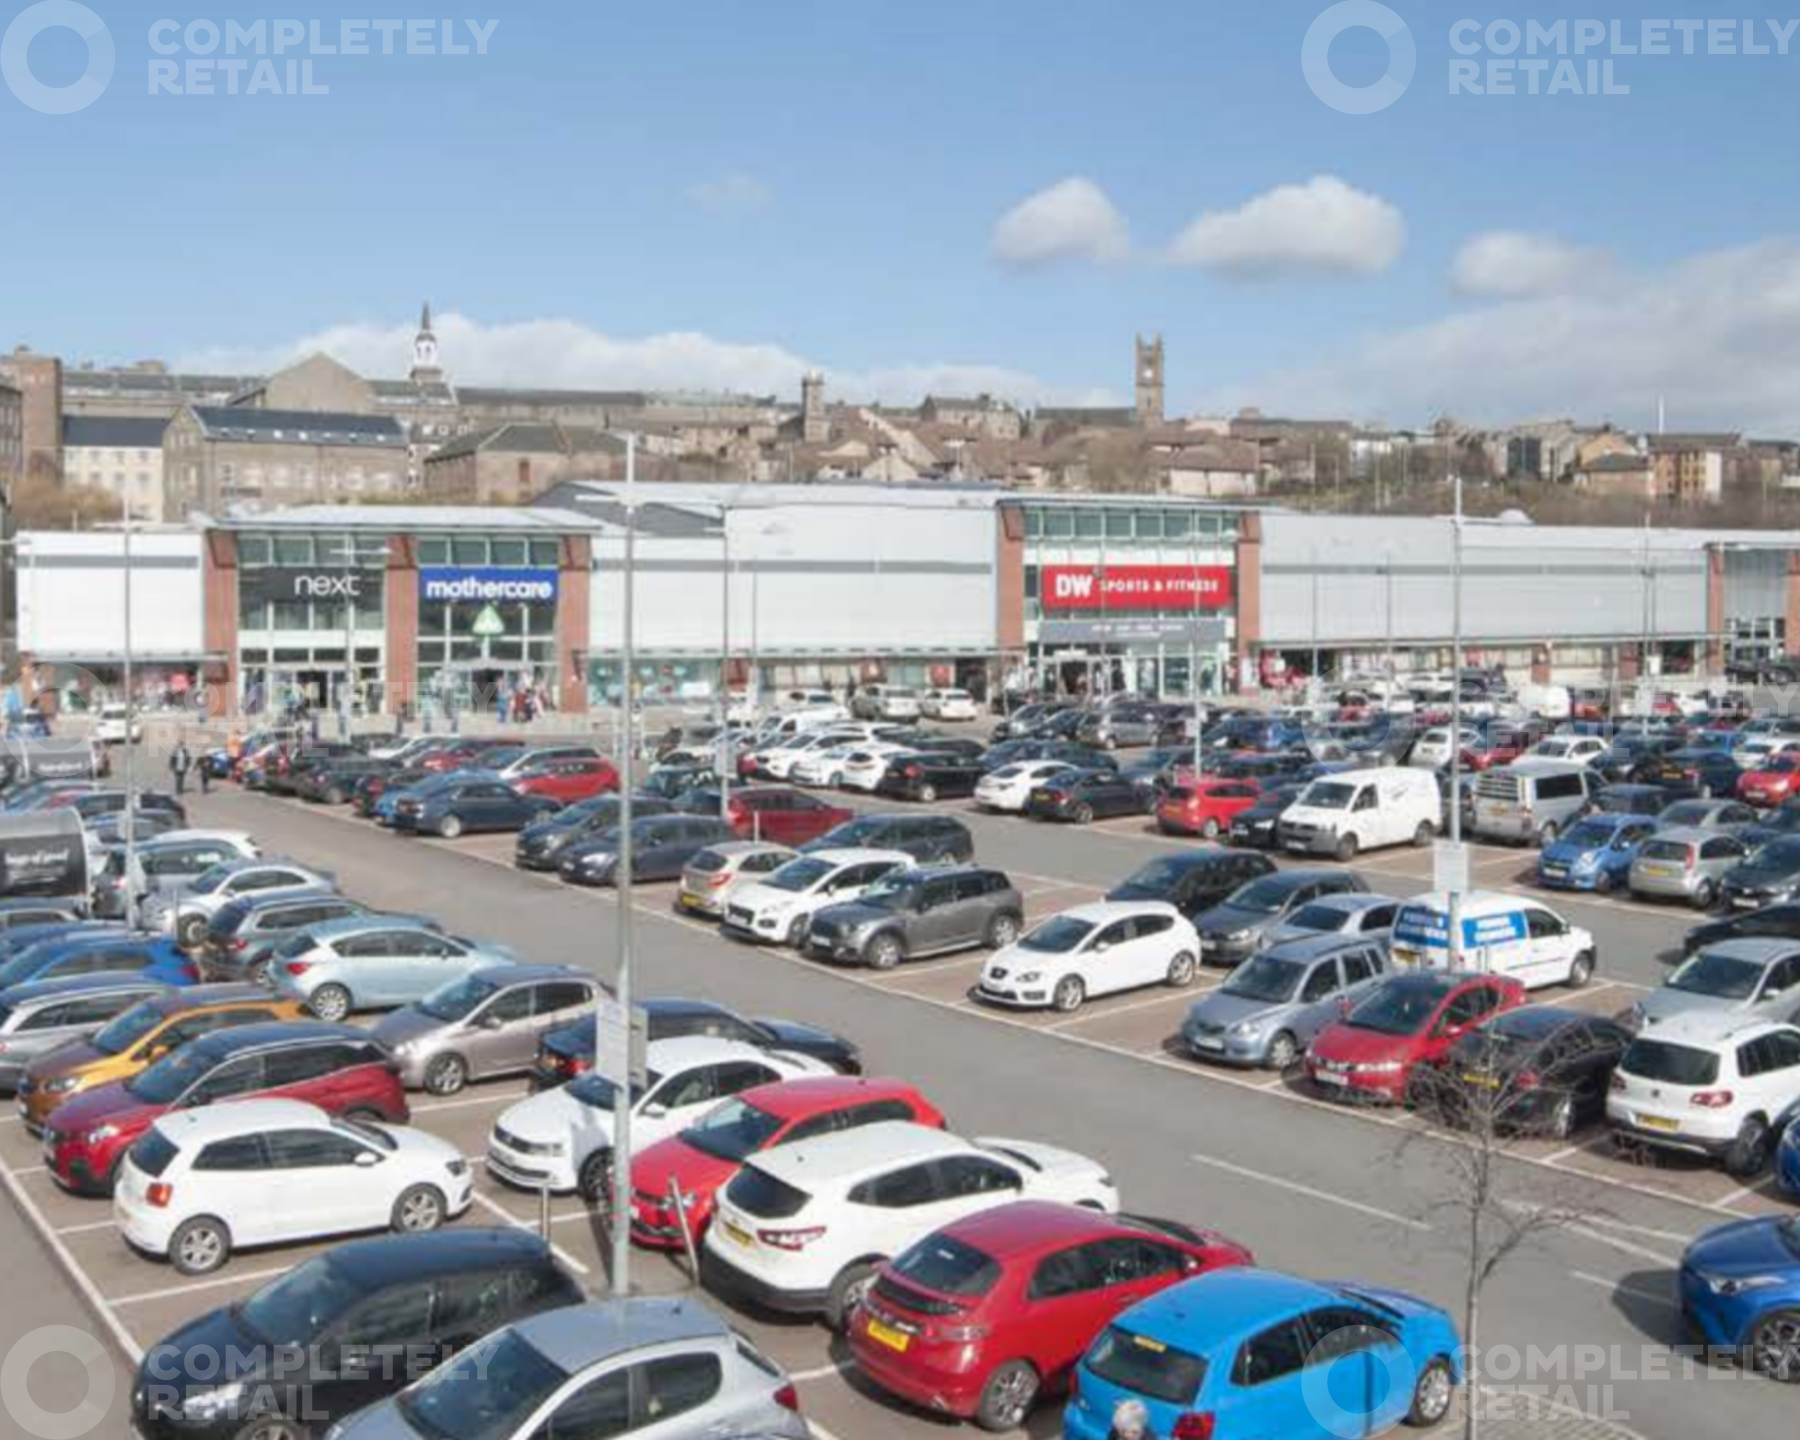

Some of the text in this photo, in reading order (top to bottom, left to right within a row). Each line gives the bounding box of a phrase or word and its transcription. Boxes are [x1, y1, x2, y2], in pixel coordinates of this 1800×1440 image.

[294, 573, 363, 597] next
[426, 576, 553, 599] mothercare
[1055, 574, 1093, 598] DW
[1099, 580, 1150, 592] SPORTS
[1166, 580, 1219, 593] FITNESS
